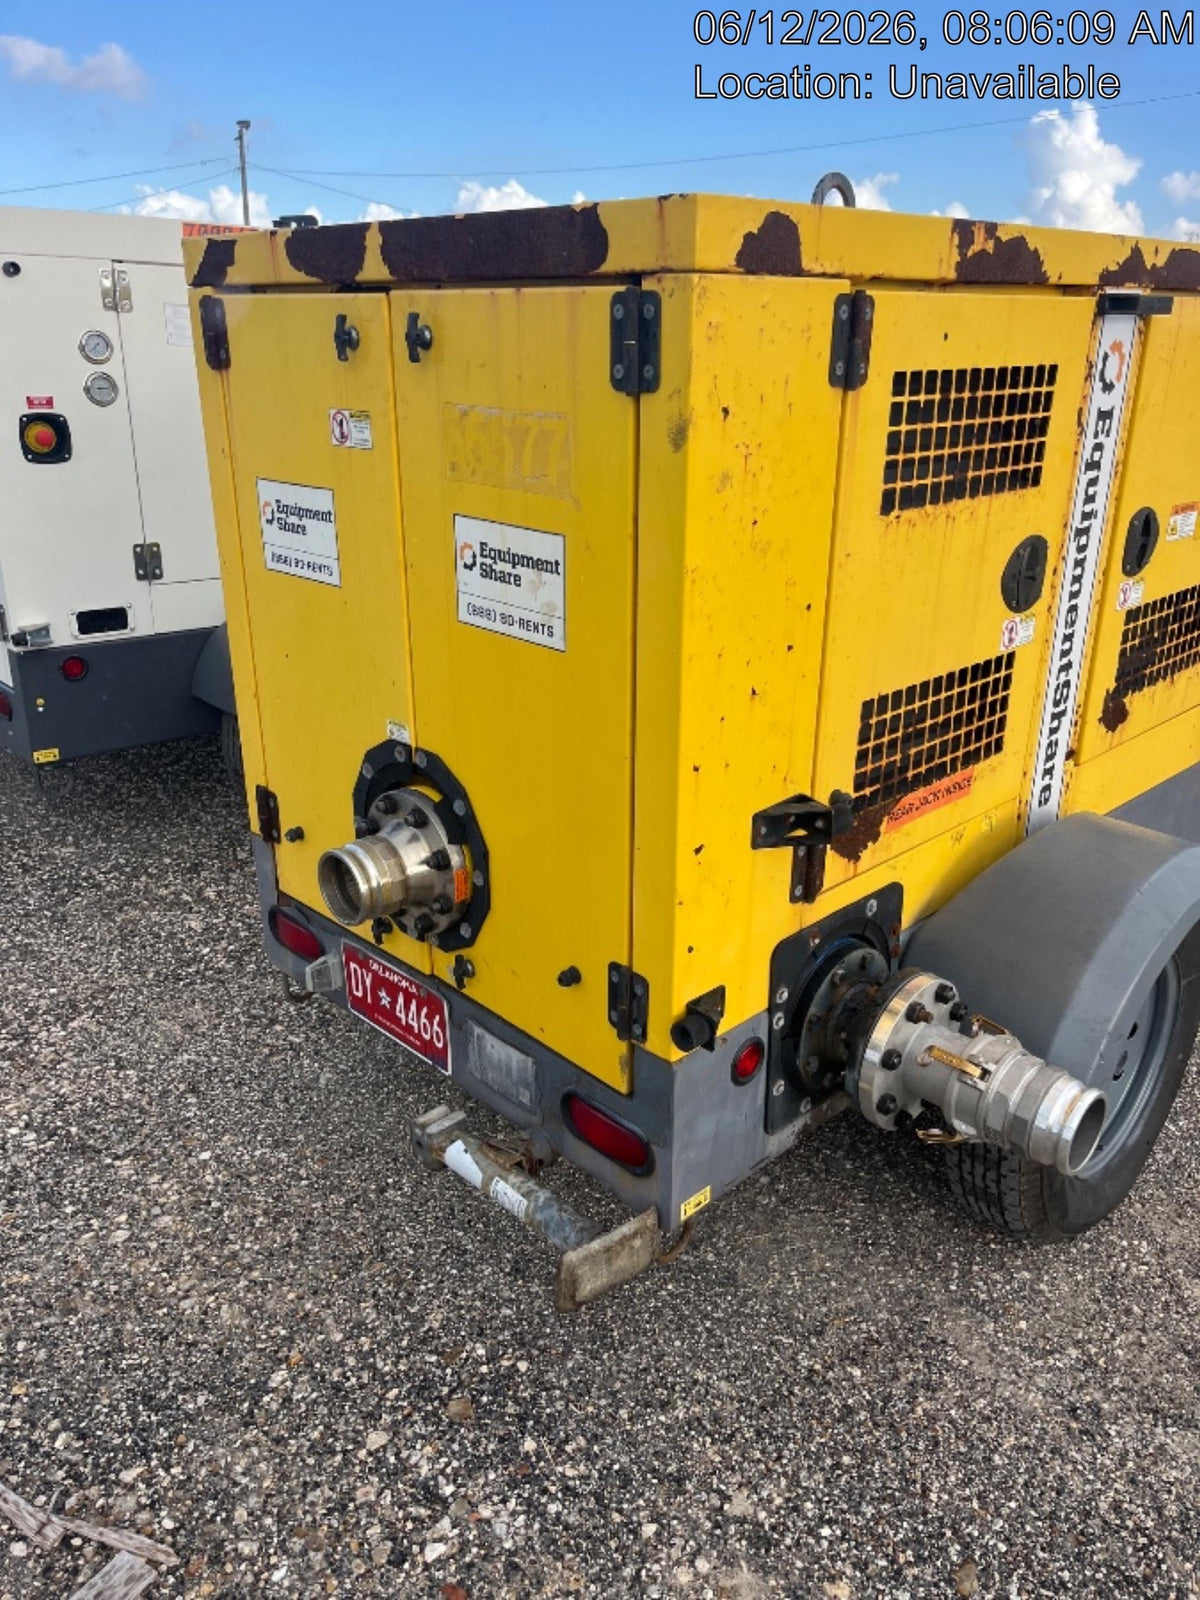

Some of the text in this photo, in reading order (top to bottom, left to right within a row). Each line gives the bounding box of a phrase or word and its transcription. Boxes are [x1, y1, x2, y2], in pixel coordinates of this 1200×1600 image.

[274, 499, 333, 524] Equipment
[276, 516, 308, 536] Share
[479, 541, 561, 576] Equipment
[479, 562, 522, 587] Share
[1037, 405, 1115, 809] EquipmentShare
[349, 961, 373, 1005] DY
[395, 991, 444, 1050] 4466
